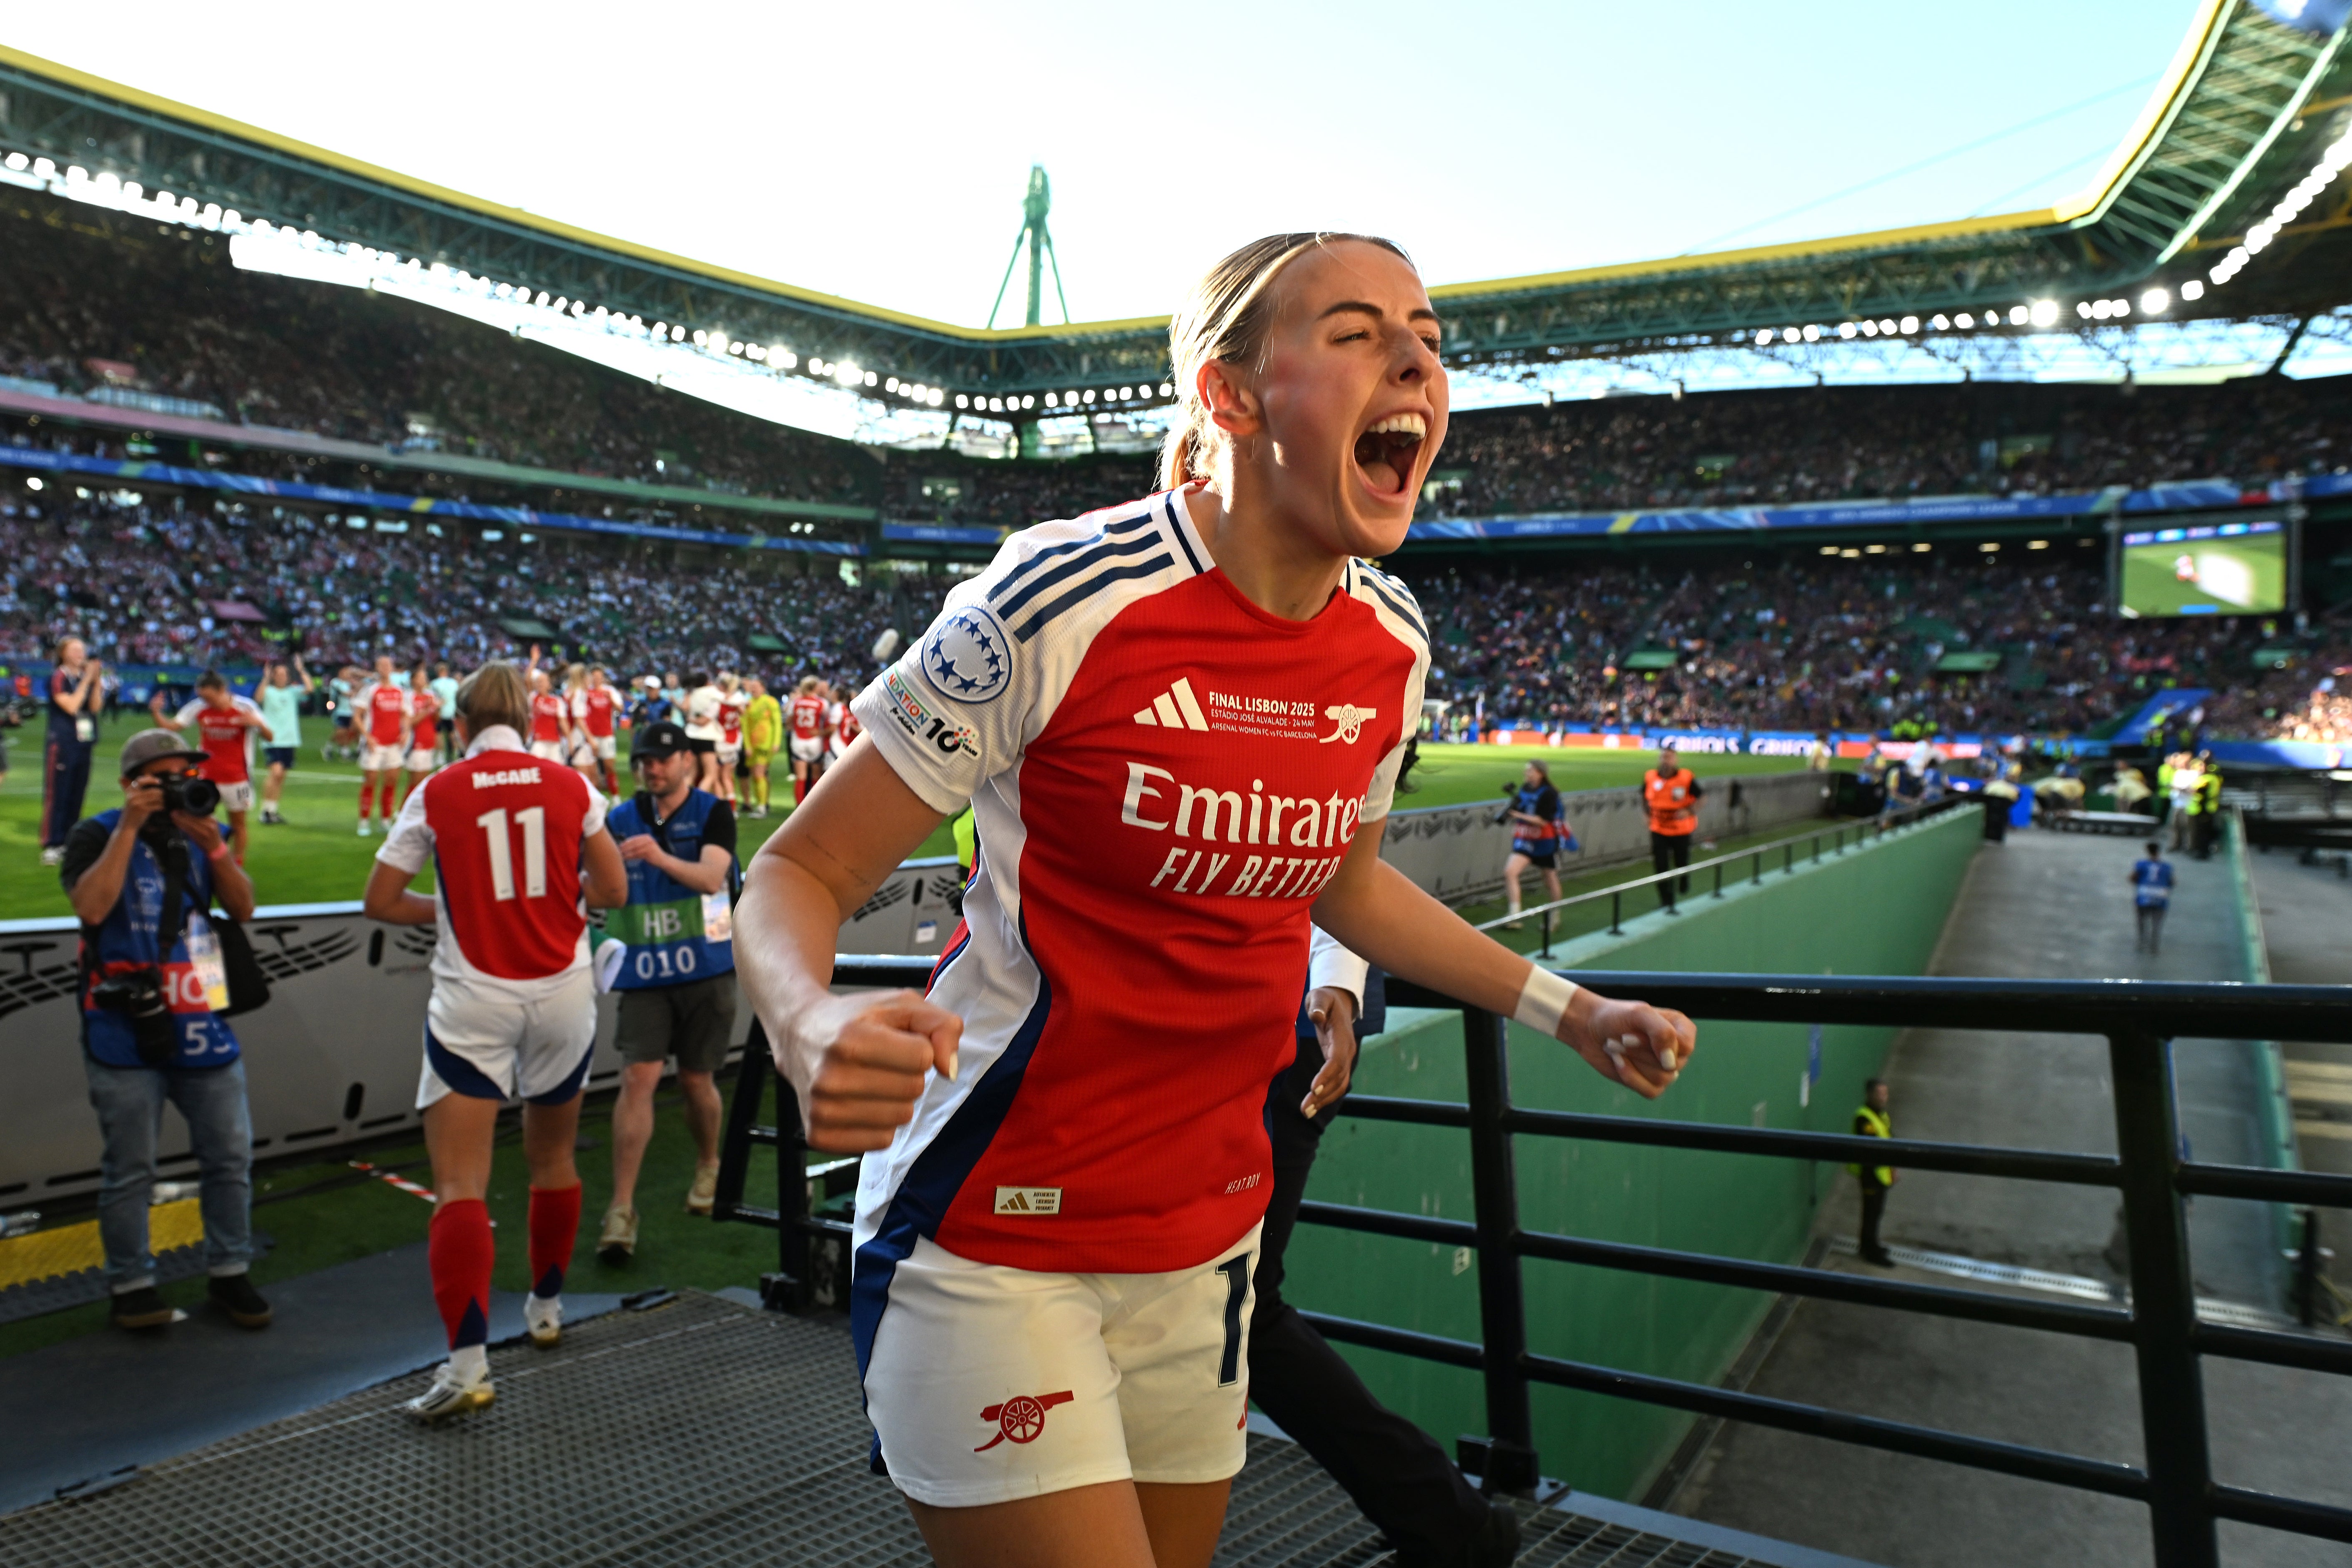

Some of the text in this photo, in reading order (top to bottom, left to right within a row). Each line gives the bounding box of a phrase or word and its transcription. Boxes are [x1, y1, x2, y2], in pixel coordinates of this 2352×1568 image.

[1209, 691, 1315, 717] FINAL LISBON 2025
[1211, 708, 1315, 728] ESTÁDIO JOSÉ ALVALADE 24 MAY
[926, 717, 961, 752] 10
[1211, 722, 1238, 733] ARSENAL
[1238, 725, 1261, 736] WOMEN
[1262, 728, 1269, 736] FC
[1276, 730, 1283, 738] FC
[1284, 730, 1317, 739] BARCELONA
[472, 767, 542, 789] McCABE
[476, 806, 547, 902] 11
[1150, 847, 1341, 897] FLY BETTER
[643, 908, 682, 939] HB
[635, 946, 696, 980] 010
[1224, 1172, 1261, 1195] HEAT.RDY
[1215, 1251, 1252, 1388] 1
